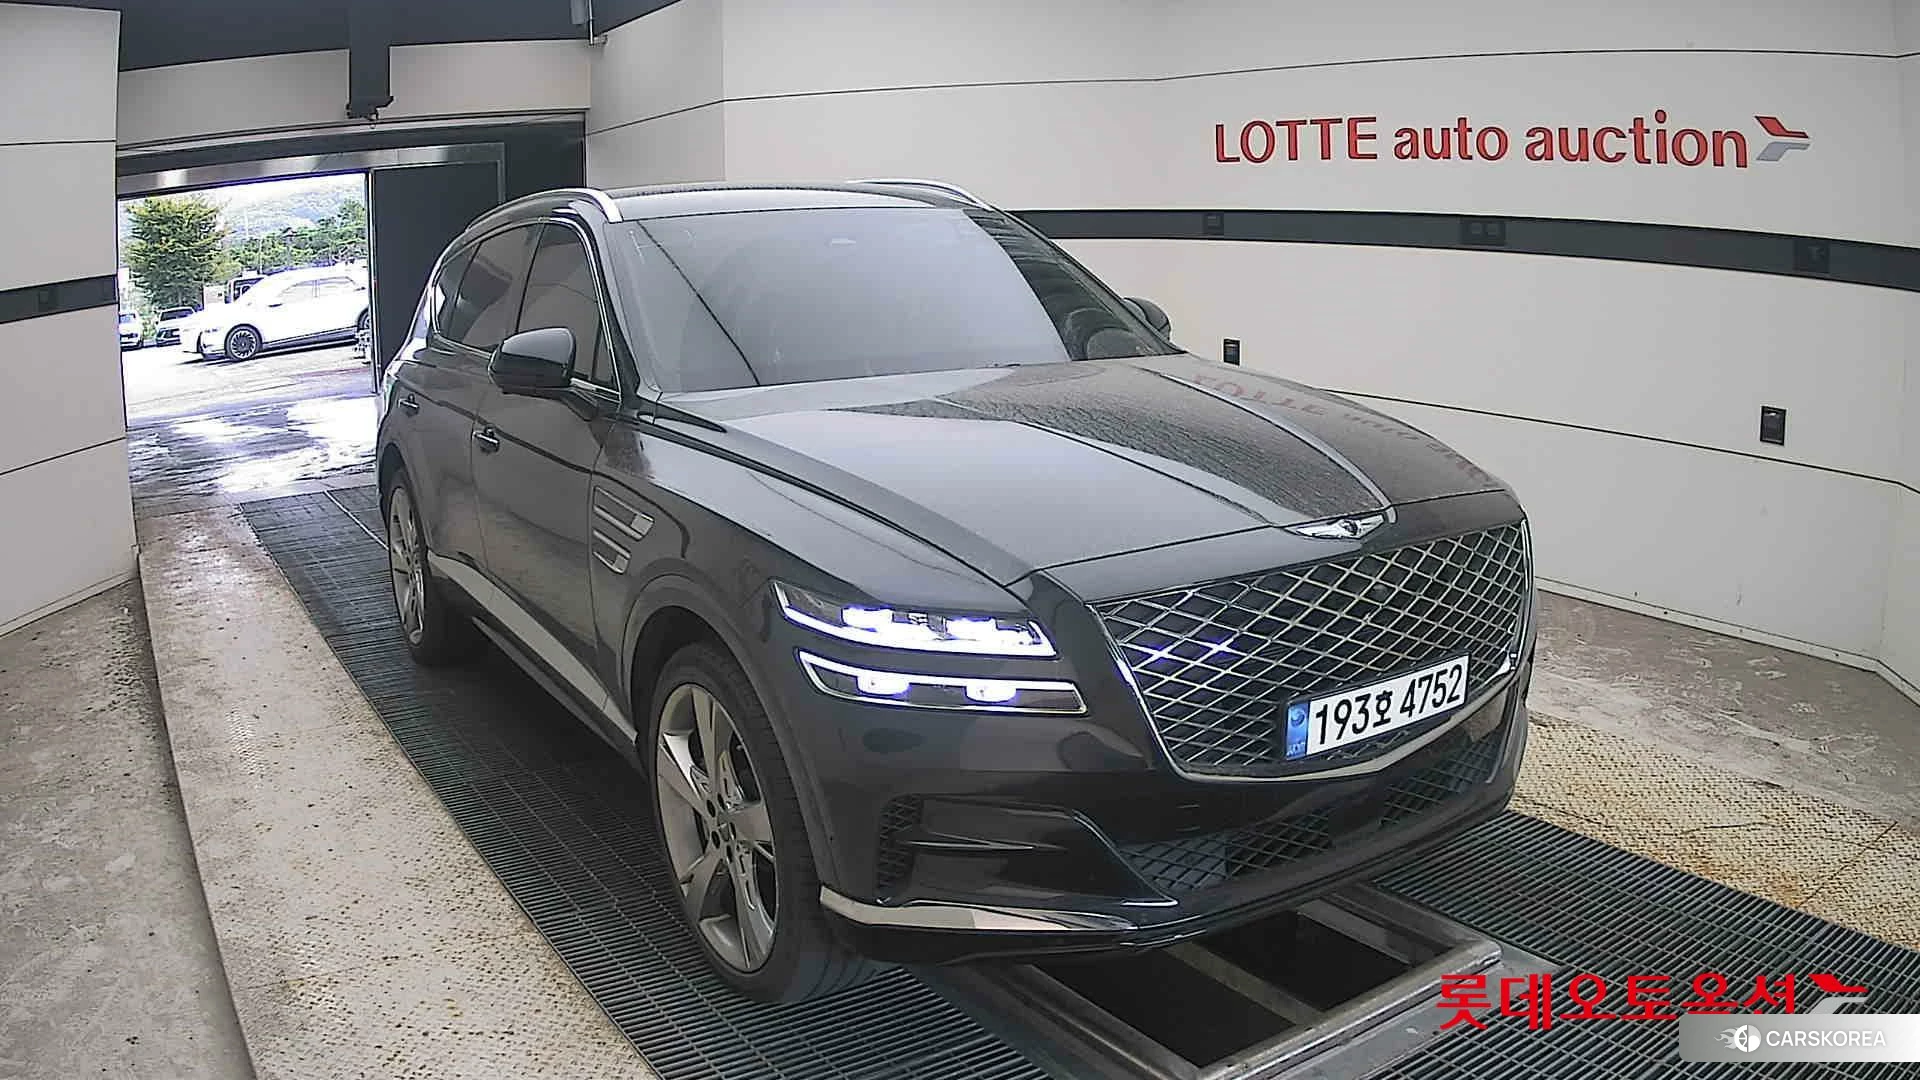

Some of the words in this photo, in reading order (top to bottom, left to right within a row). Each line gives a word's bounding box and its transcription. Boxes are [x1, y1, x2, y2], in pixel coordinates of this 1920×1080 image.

[1215, 116, 1378, 163] LOTTE
[1393, 116, 1510, 161] auto
[1525, 109, 1749, 168] auction
[1315, 689, 1393, 745] 193호
[1399, 663, 1463, 718] 4752
